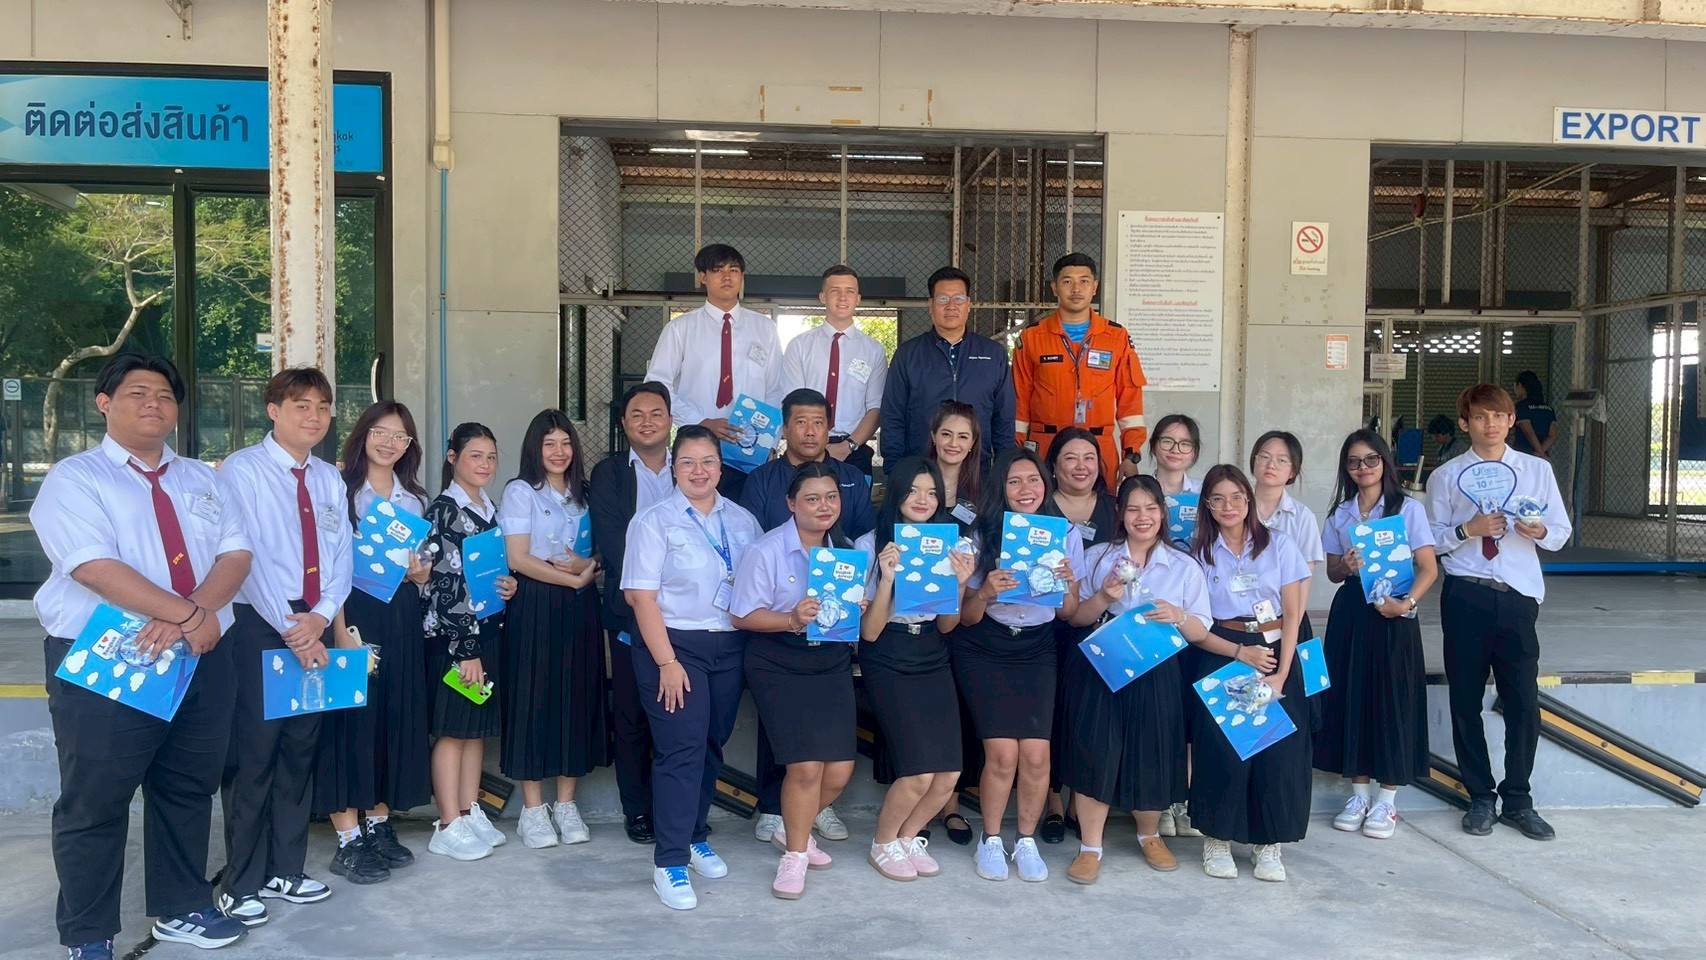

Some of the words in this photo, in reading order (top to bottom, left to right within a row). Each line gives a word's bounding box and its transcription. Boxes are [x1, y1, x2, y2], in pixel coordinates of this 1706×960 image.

[25, 101, 249, 142] ติดต่อส่งสินค้า
[1562, 111, 1701, 143] EXPORT
